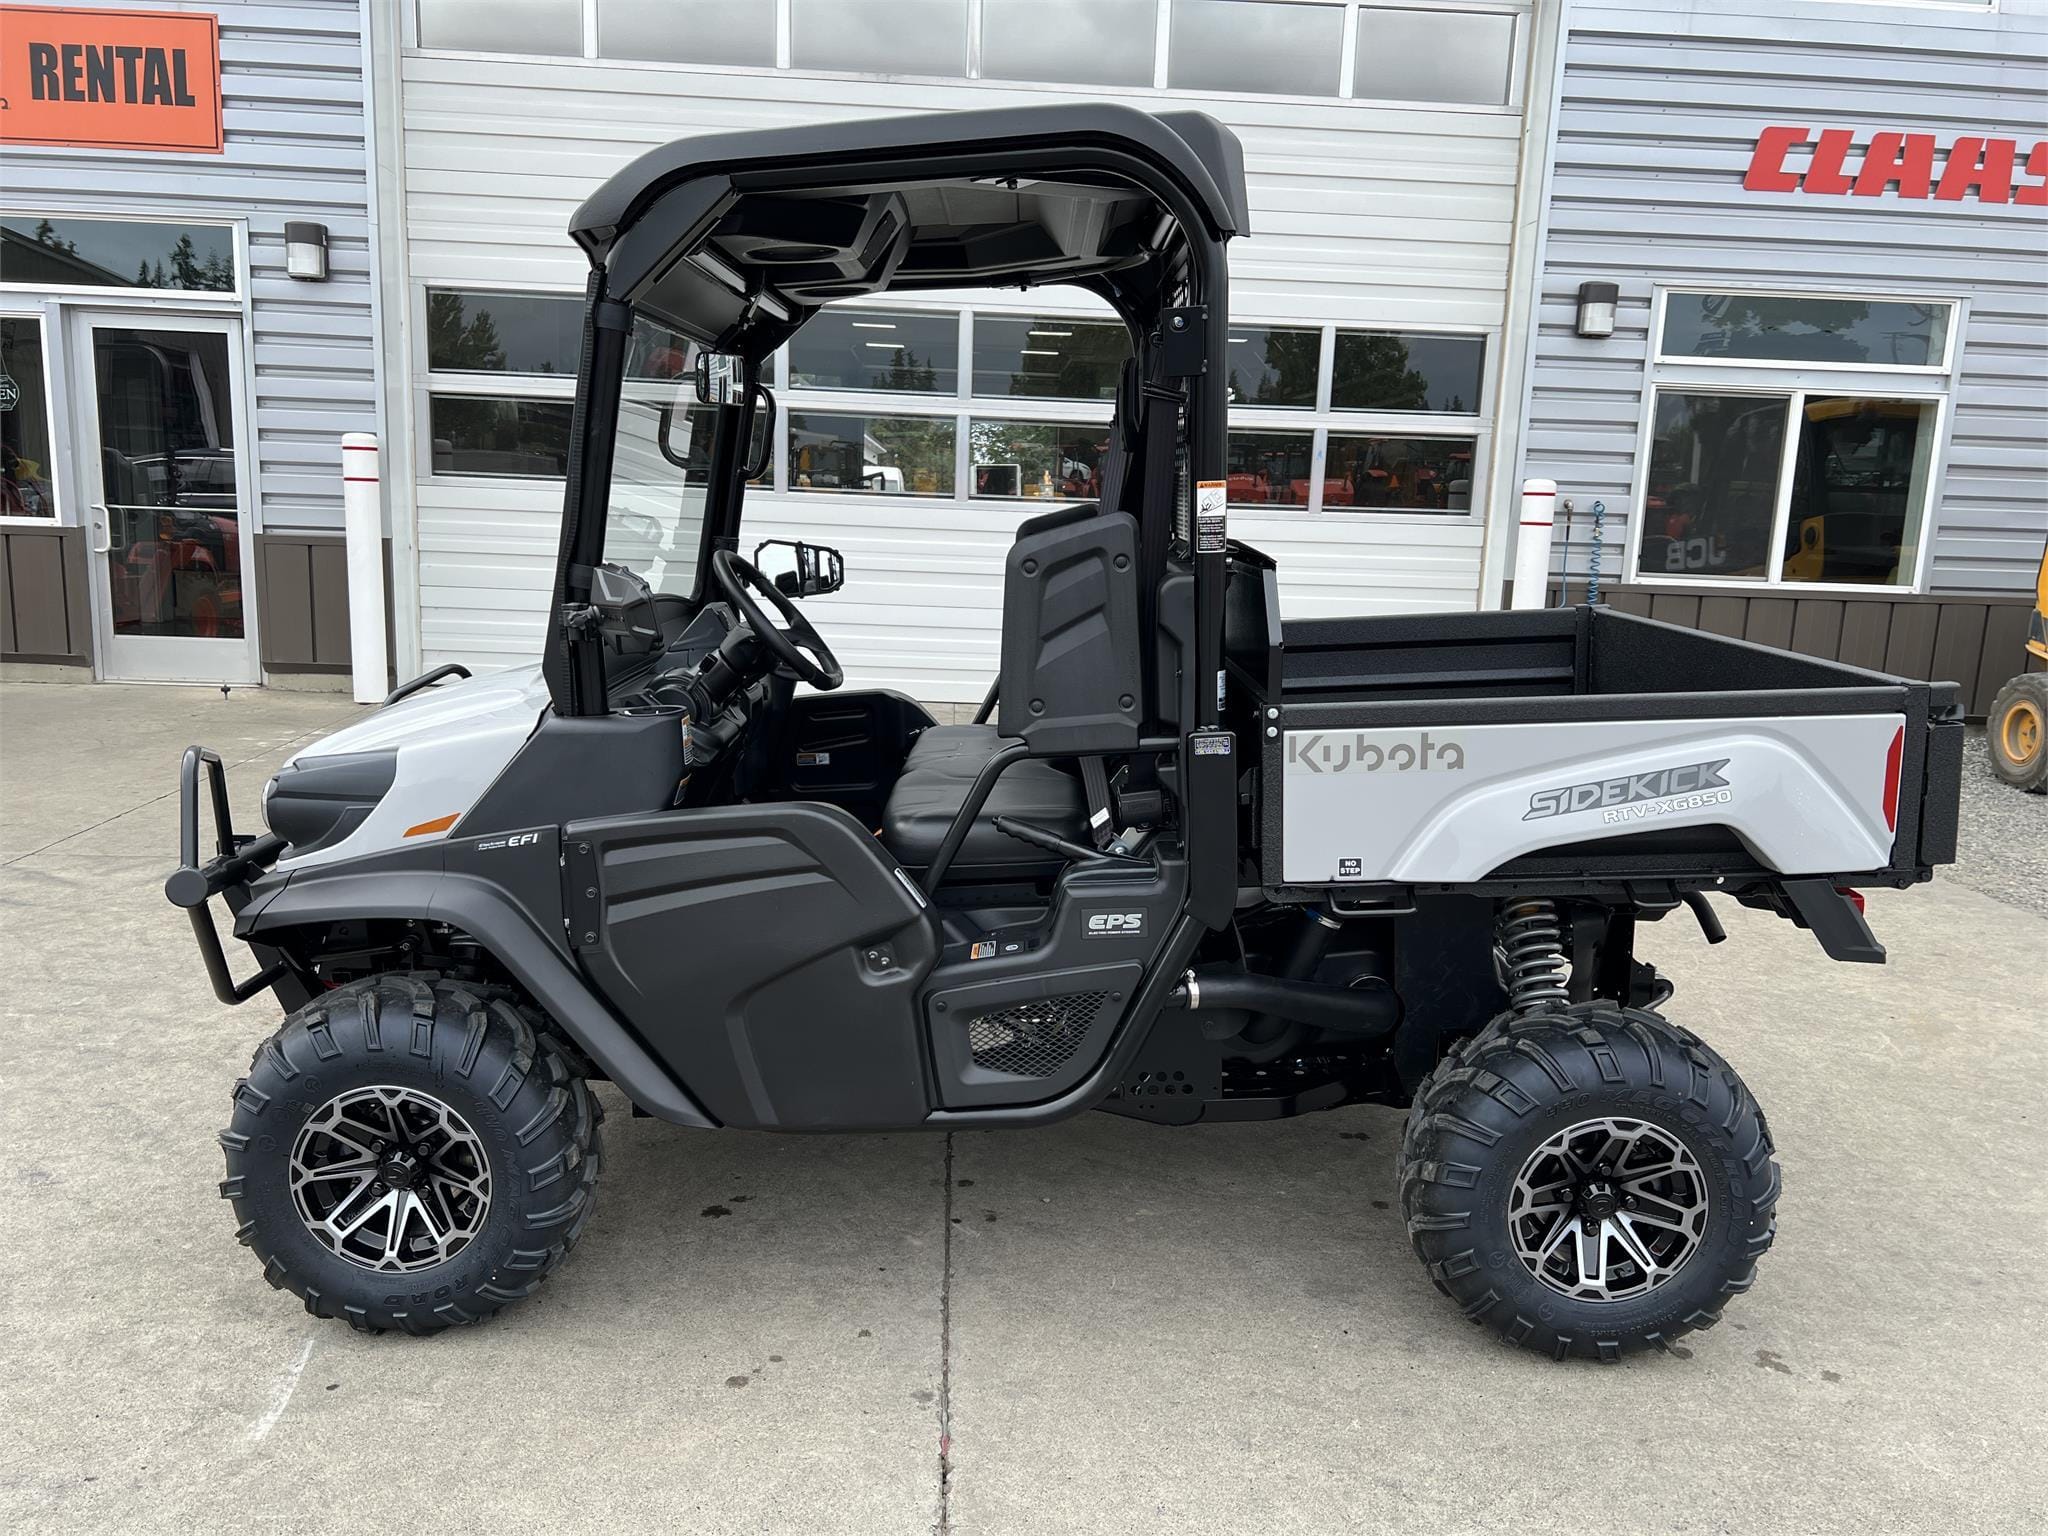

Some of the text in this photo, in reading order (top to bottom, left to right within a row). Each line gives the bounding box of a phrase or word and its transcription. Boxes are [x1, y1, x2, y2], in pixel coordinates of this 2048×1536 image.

[29, 42, 196, 107] RENTAL
[1288, 732, 1465, 773] Kubota
[1522, 758, 1731, 821] SIDEKICK
[1603, 790, 1732, 824] RTV-XG850
[508, 833, 538, 846] EFI
[1088, 913, 1142, 930] EPS
